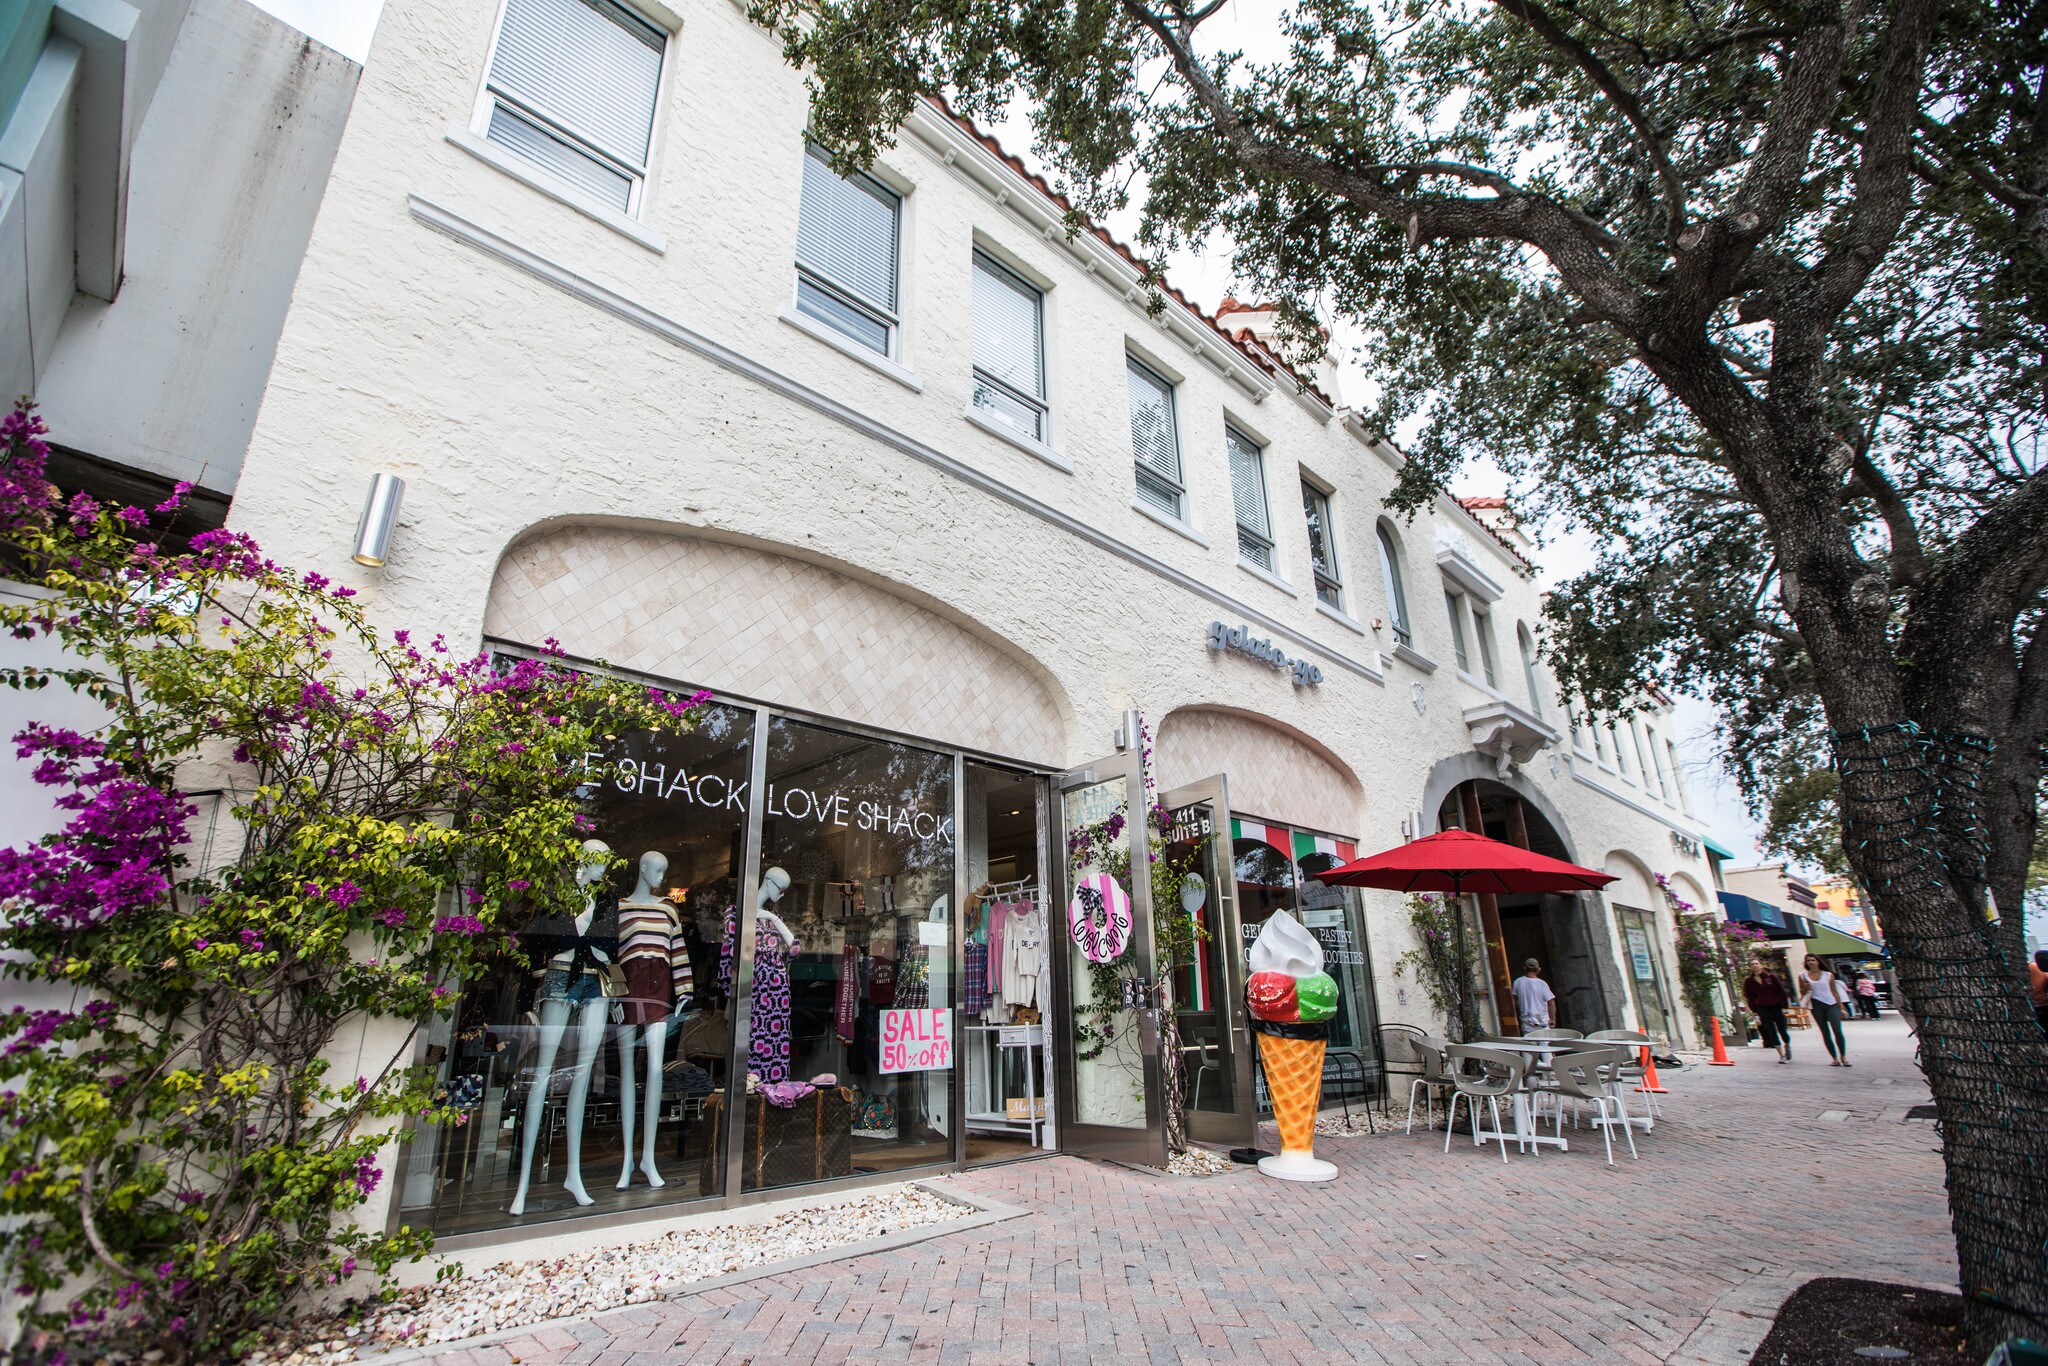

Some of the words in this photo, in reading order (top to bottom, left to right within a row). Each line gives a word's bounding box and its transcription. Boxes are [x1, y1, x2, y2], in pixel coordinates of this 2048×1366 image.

[1207, 620, 1324, 686] gelato-go
[615, 758, 749, 813] SHACK
[767, 784, 850, 827] LOVE
[857, 801, 952, 843] SHACK
[1175, 806, 1196, 823] 411
[1165, 823, 1199, 845] SUITE
[1201, 819, 1211, 835] B
[1319, 928, 1352, 944] PASTRY
[840, 983, 849, 1024] TOGETHER
[883, 1008, 947, 1043] SALE
[882, 1043, 918, 1070] 50%
